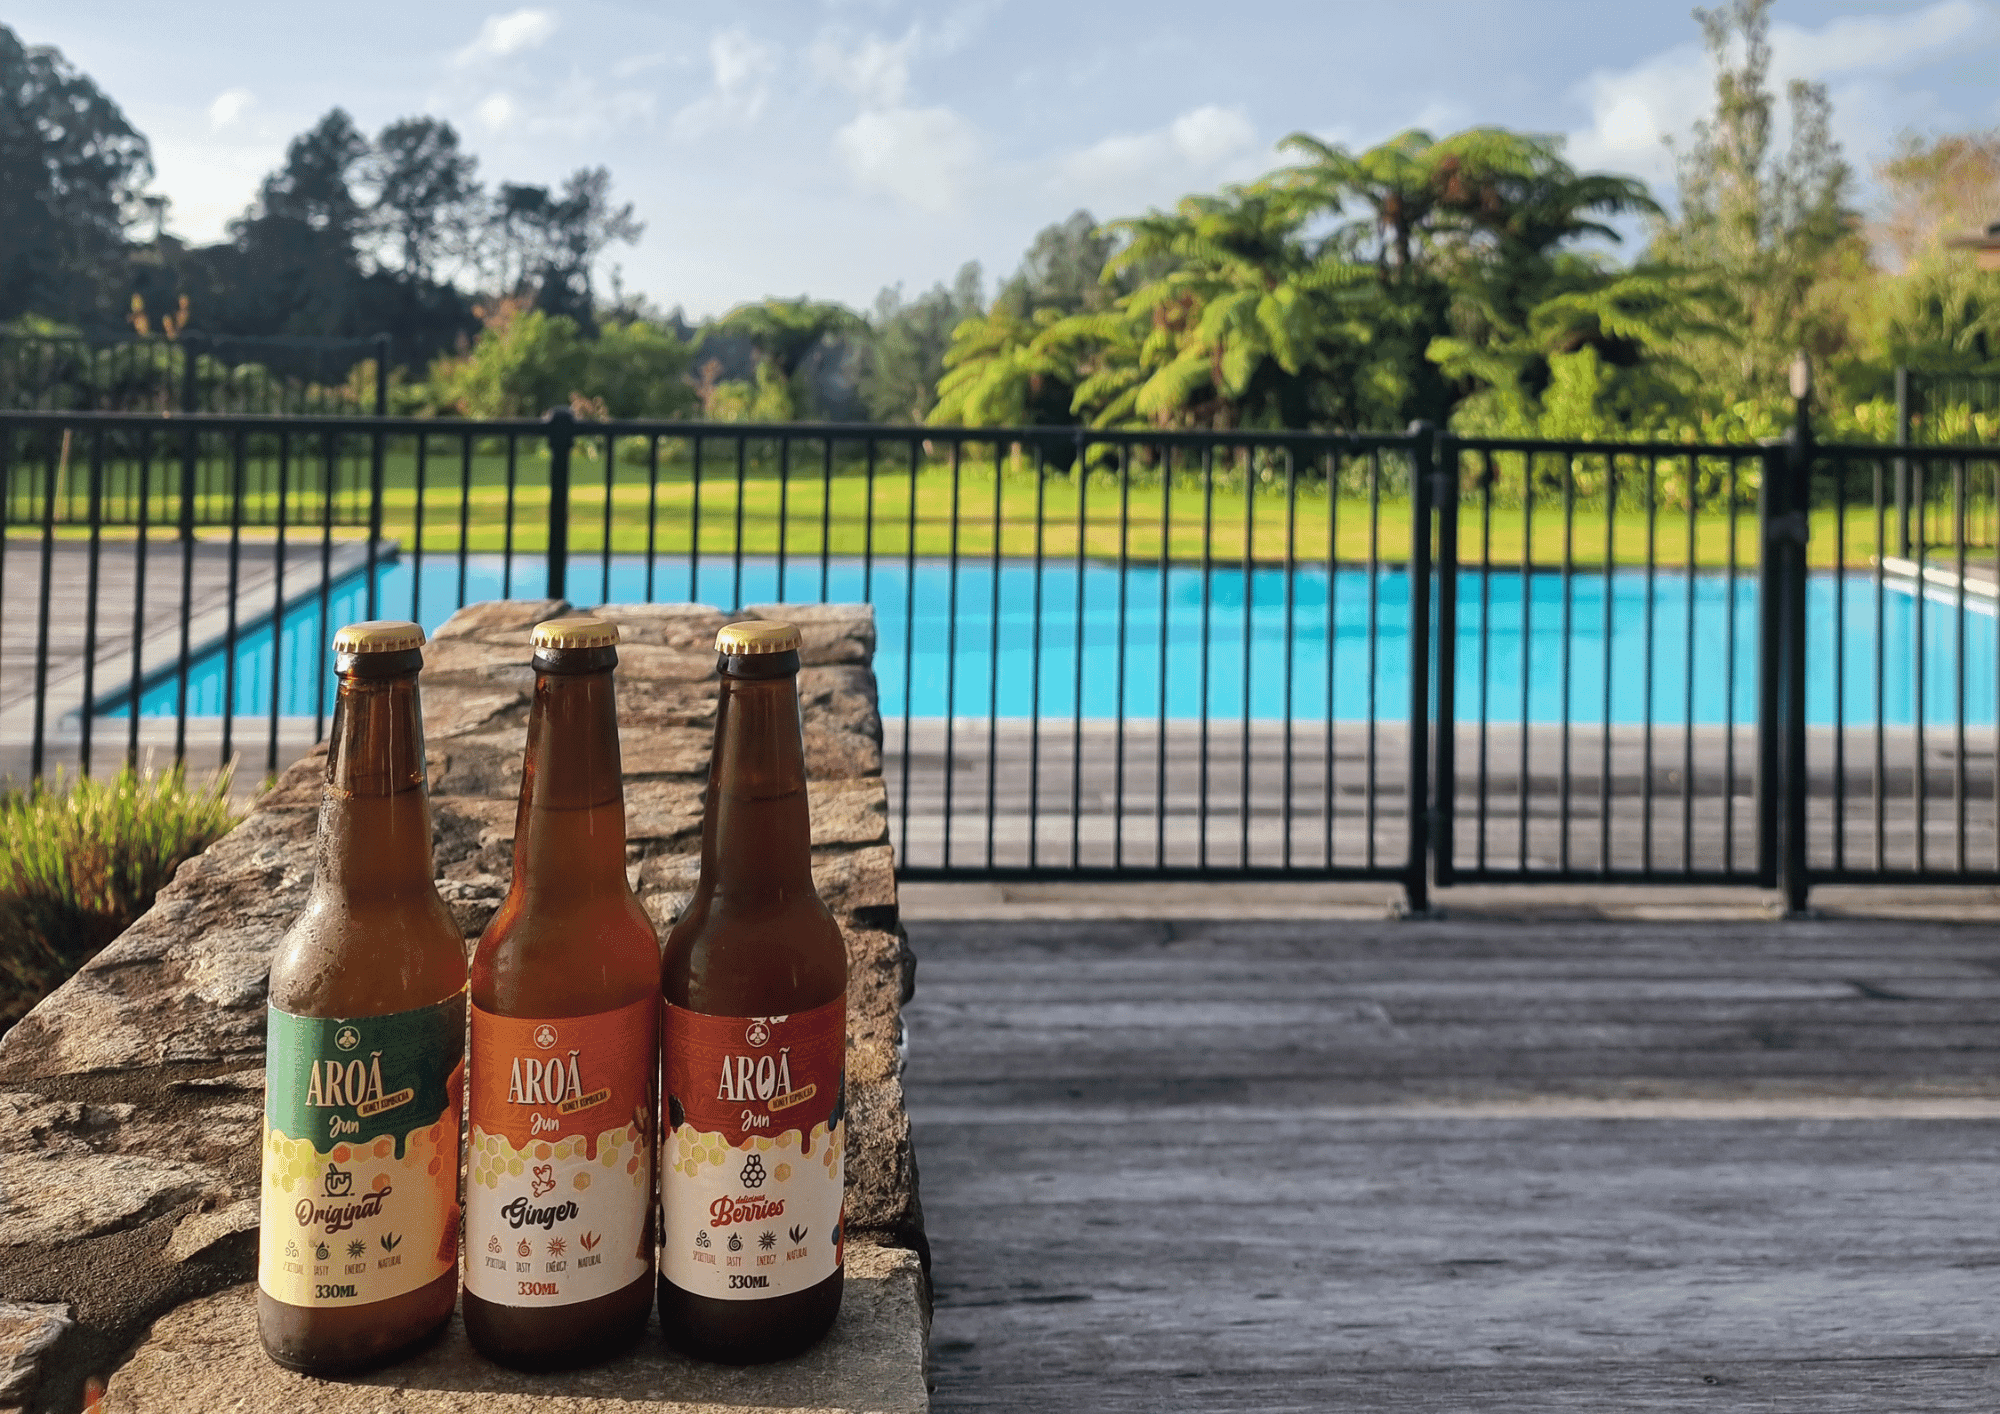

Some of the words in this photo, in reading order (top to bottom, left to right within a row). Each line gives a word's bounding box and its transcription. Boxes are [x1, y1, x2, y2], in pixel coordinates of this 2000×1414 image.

[305, 1050, 384, 1106] AROÃ
[507, 1049, 583, 1105] AROÃ
[717, 1046, 792, 1101] AROÃ
[329, 1115, 359, 1138] Jun
[530, 1112, 560, 1135] Jun
[741, 1109, 770, 1132] Jun
[295, 1186, 392, 1234] Original
[735, 1194, 766, 1204] delicious
[501, 1196, 579, 1230] Ginger
[710, 1195, 785, 1227] Berries
[314, 1265, 329, 1276] TASTY
[344, 1262, 366, 1275] ENERGY
[377, 1255, 402, 1269] NATURAL
[516, 1261, 531, 1273] TASTY
[545, 1260, 567, 1273] ENERGY
[577, 1253, 602, 1269] NATURAL
[726, 1256, 742, 1267] TASTY
[756, 1254, 777, 1266] ENERGY
[786, 1246, 808, 1261] NATURAL
[315, 1284, 358, 1299] 330ML
[517, 1281, 559, 1296] 330ML
[728, 1274, 770, 1289] 330ML
